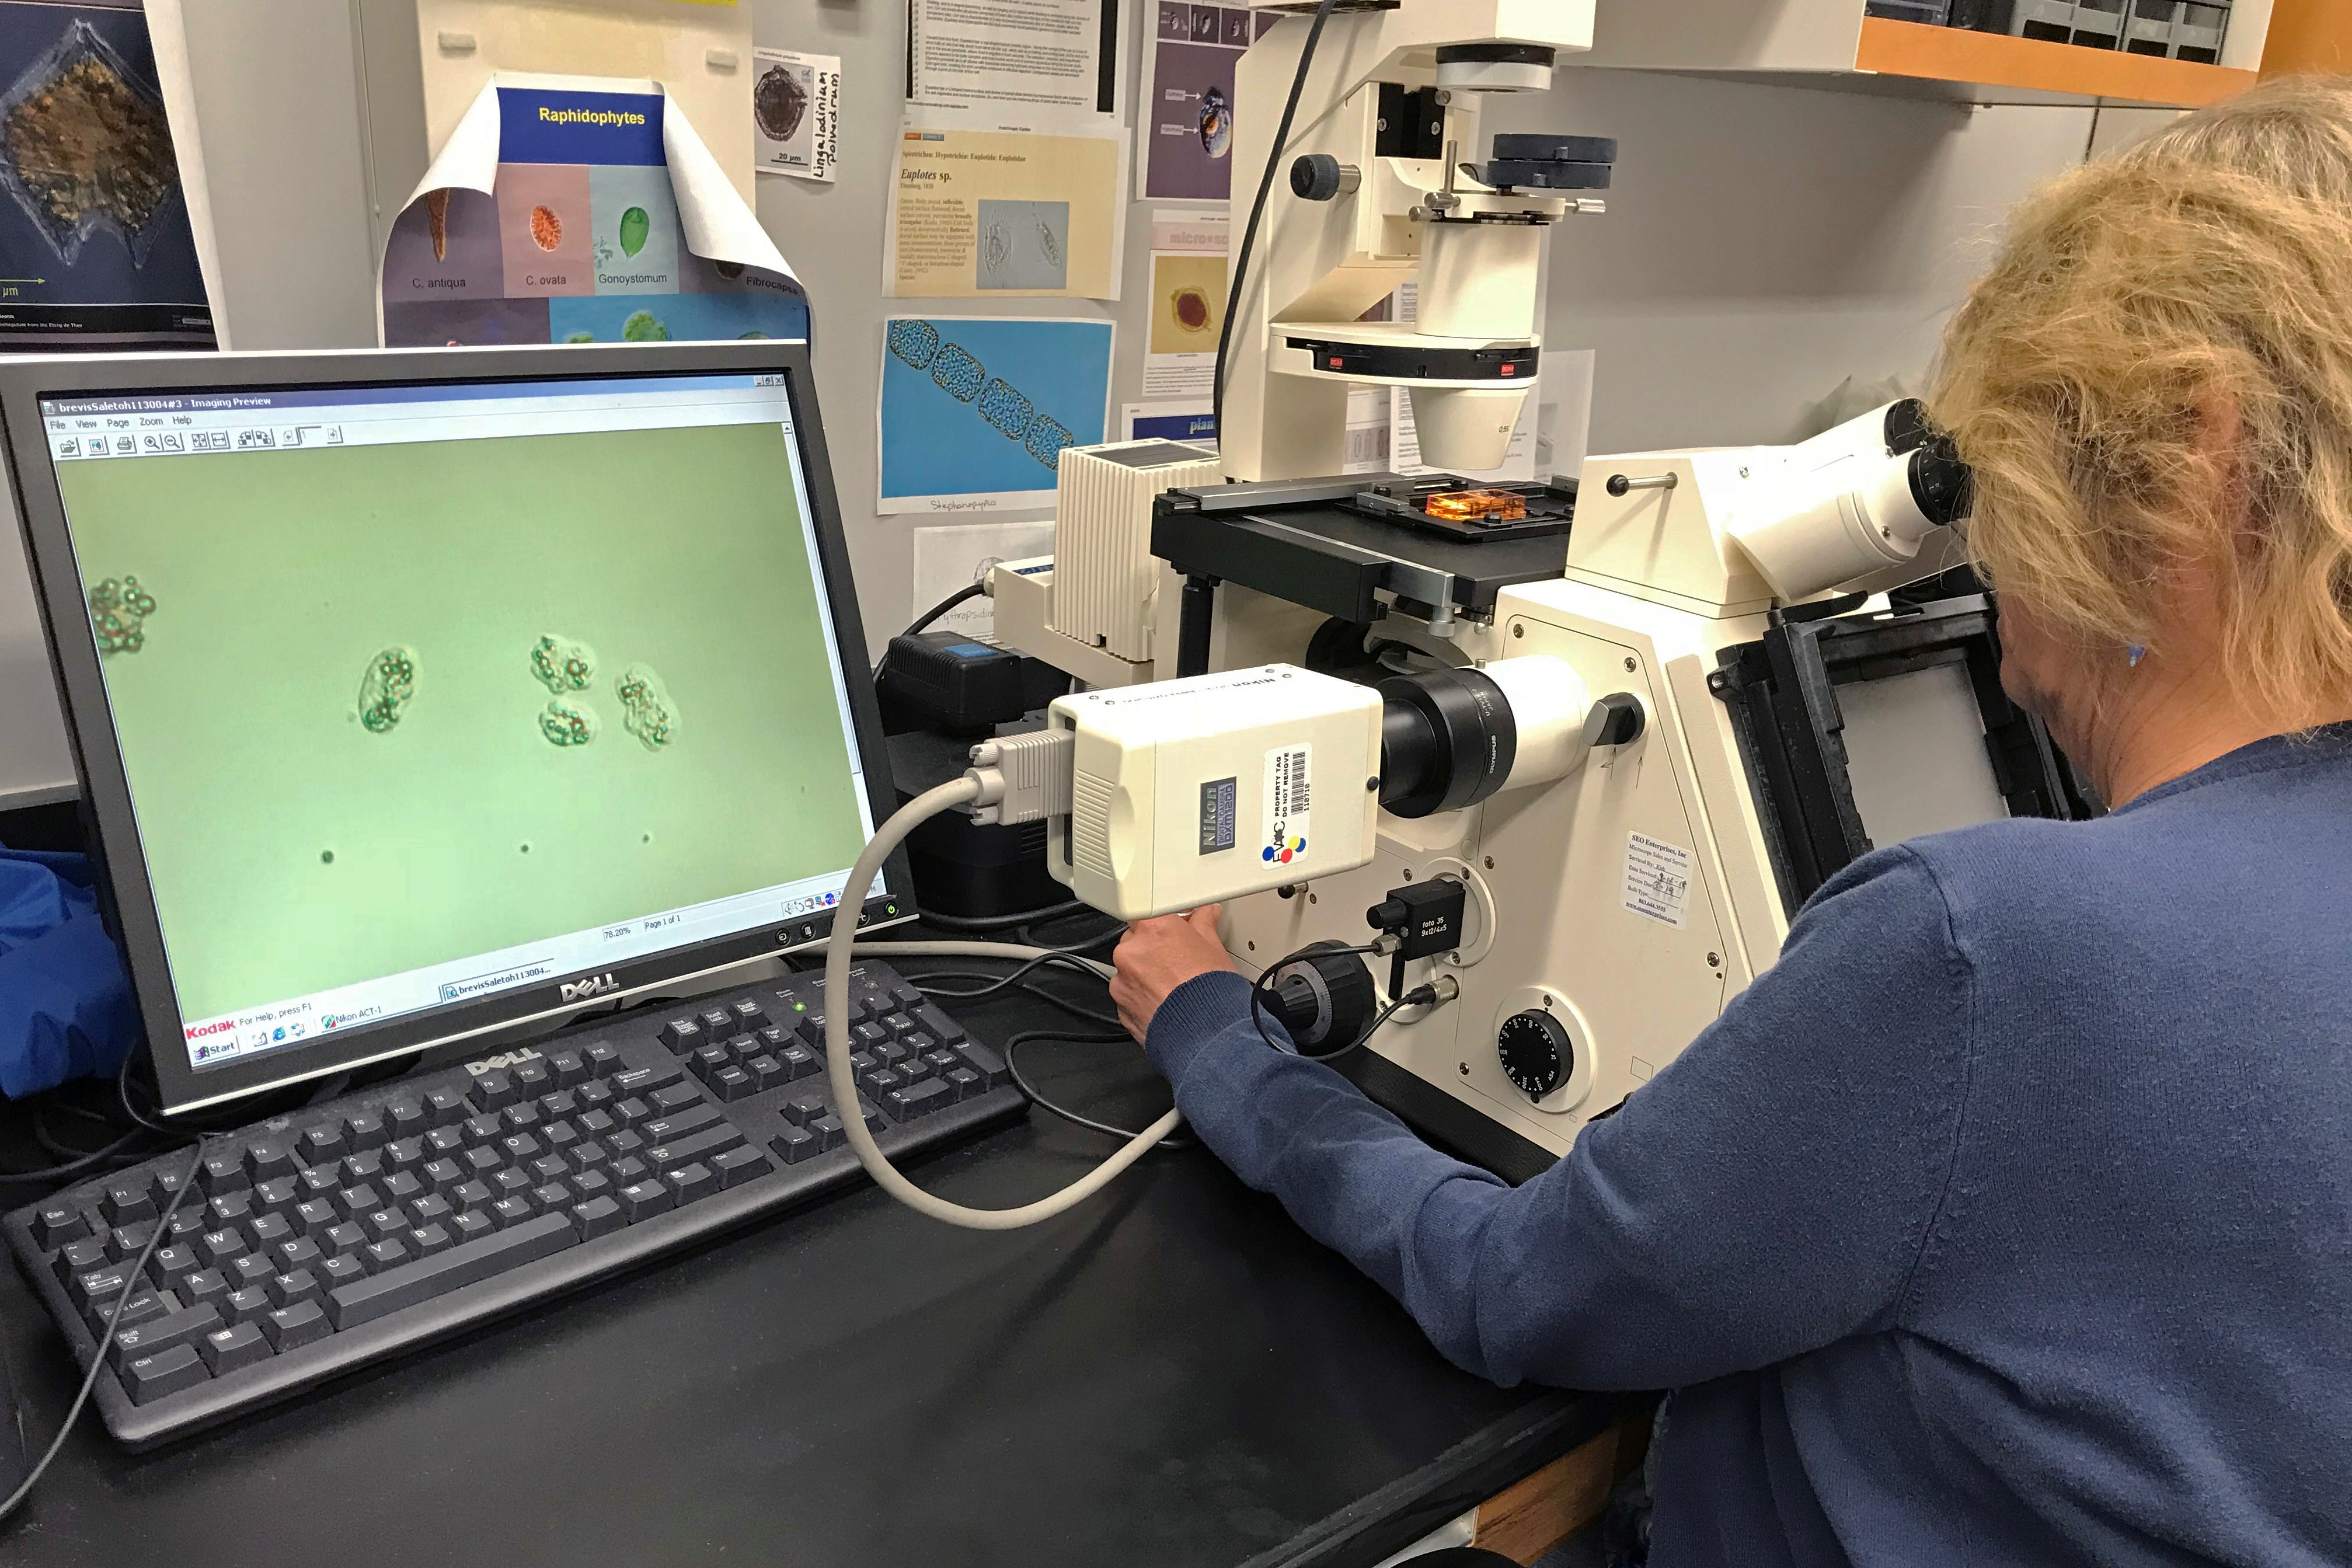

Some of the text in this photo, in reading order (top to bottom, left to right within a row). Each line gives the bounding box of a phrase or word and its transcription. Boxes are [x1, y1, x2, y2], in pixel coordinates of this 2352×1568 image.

[539, 107, 645, 126] Raphidophytes
[901, 169, 952, 182] Euplotes sp.
[412, 277, 466, 290] C. antiqua
[526, 275, 566, 285] C. ovata
[598, 273, 667, 284] Gonoystomum
[191, 398, 232, 410] Imaging
[234, 397, 271, 406] Preview
[50, 416, 191, 429] File View Page Zoom Help
[1480, 691, 1493, 711] JAPAN
[1203, 788, 1216, 845] Nikon
[1283, 807, 1287, 817] DO
[1632, 835, 1687, 858] SEO Enterprises, Inc
[1629, 844, 1652, 856] Microscope
[1672, 859, 1688, 868] Service
[1629, 855, 1646, 865] Serviced
[1628, 875, 1643, 884] Service
[604, 927, 630, 939] 78.20%
[646, 919, 661, 929] Page
[1421, 924, 1447, 936] 9x12/4x5
[559, 973, 619, 1002] DELL
[239, 1003, 312, 1026] For Help, press F1
[336, 1006, 382, 1023] Nikon ACT-1
[186, 1020, 236, 1040] Kodak
[736, 1039, 752, 1047] Home
[210, 1043, 235, 1055] Start
[464, 1047, 542, 1076] DELL
[618, 1068, 651, 1080] Backspace
[723, 1071, 741, 1079] Delete
[545, 1126, 554, 1134] P
[428, 1163, 440, 1172] U
[387, 1176, 396, 1184] Y
[345, 1190, 354, 1198] T
[416, 1199, 429, 1207] H
[301, 1205, 313, 1213] R
[375, 1213, 388, 1221] G
[255, 1219, 267, 1228] E
[330, 1228, 340, 1236] F
[208, 1233, 224, 1243] W
[371, 1244, 381, 1252] V
[161, 1249, 175, 1258] Q
[238, 1259, 250, 1267] S
[192, 1275, 204, 1284] A
[280, 1276, 293, 1284] X
[232, 1292, 245, 1301] Z
[129, 1298, 151, 1308] Lock
[119, 1330, 139, 1339] Shift
[135, 1358, 152, 1367] Ctrl
